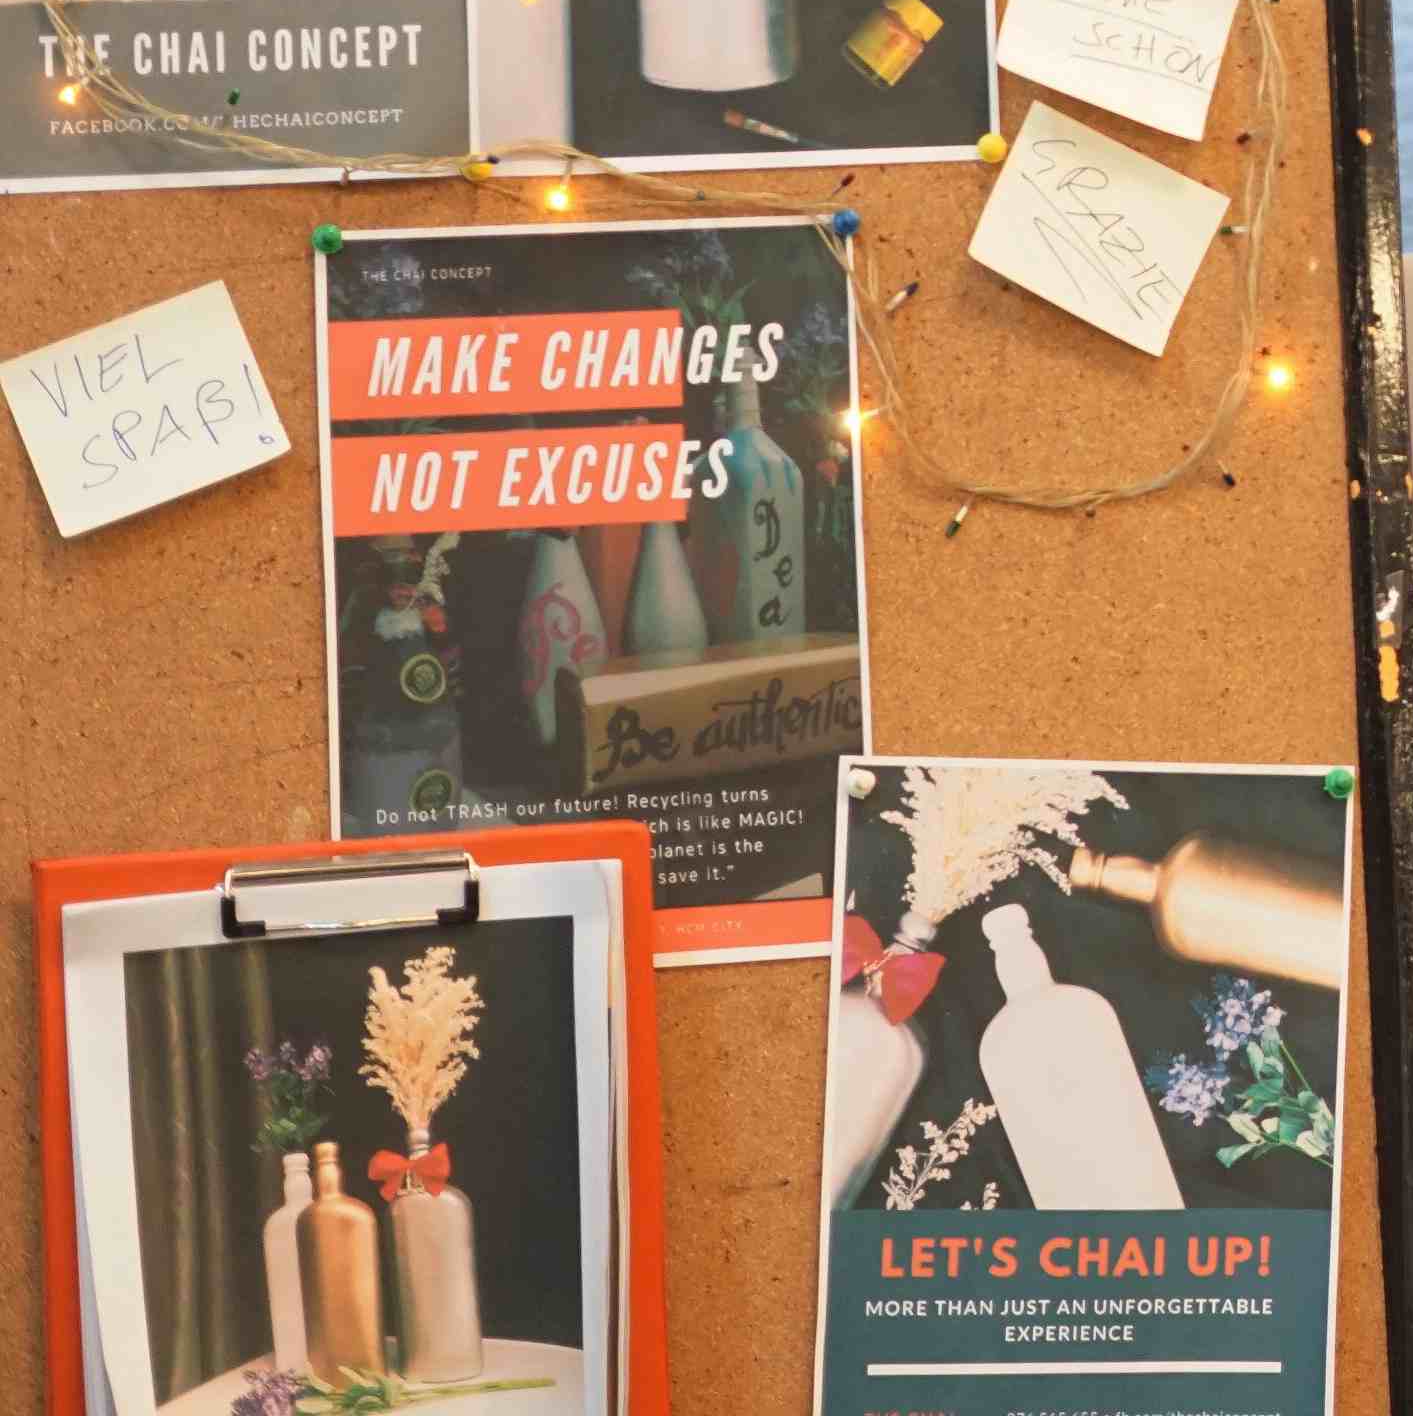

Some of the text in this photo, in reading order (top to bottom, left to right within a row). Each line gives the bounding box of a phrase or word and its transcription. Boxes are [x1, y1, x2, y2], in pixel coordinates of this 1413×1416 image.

[133, 31, 225, 75] CHAI
[248, 25, 422, 72] CONCEPT
[362, 270, 389, 282] THE
[431, 265, 493, 281] CONCEPT
[367, 322, 786, 398] MAKE CHANGES
[30, 334, 184, 417] VIEL
[369, 437, 736, 514] NOT EXCUSES
[376, 788, 770, 825] Do not TRASH our future! Recycling turns
[676, 816, 691, 832] is
[699, 815, 732, 831] like
[739, 809, 805, 827] MAGIC!
[711, 840, 728, 856] is
[734, 838, 765, 854] the
[658, 869, 699, 885] save
[880, 1235, 1272, 1279] LET'S CHAI UP!
[865, 1297, 1273, 1317] MORE THAN JUST AN UNFORGETTABLE
[1004, 1324, 1135, 1343] EXPERIENCE
